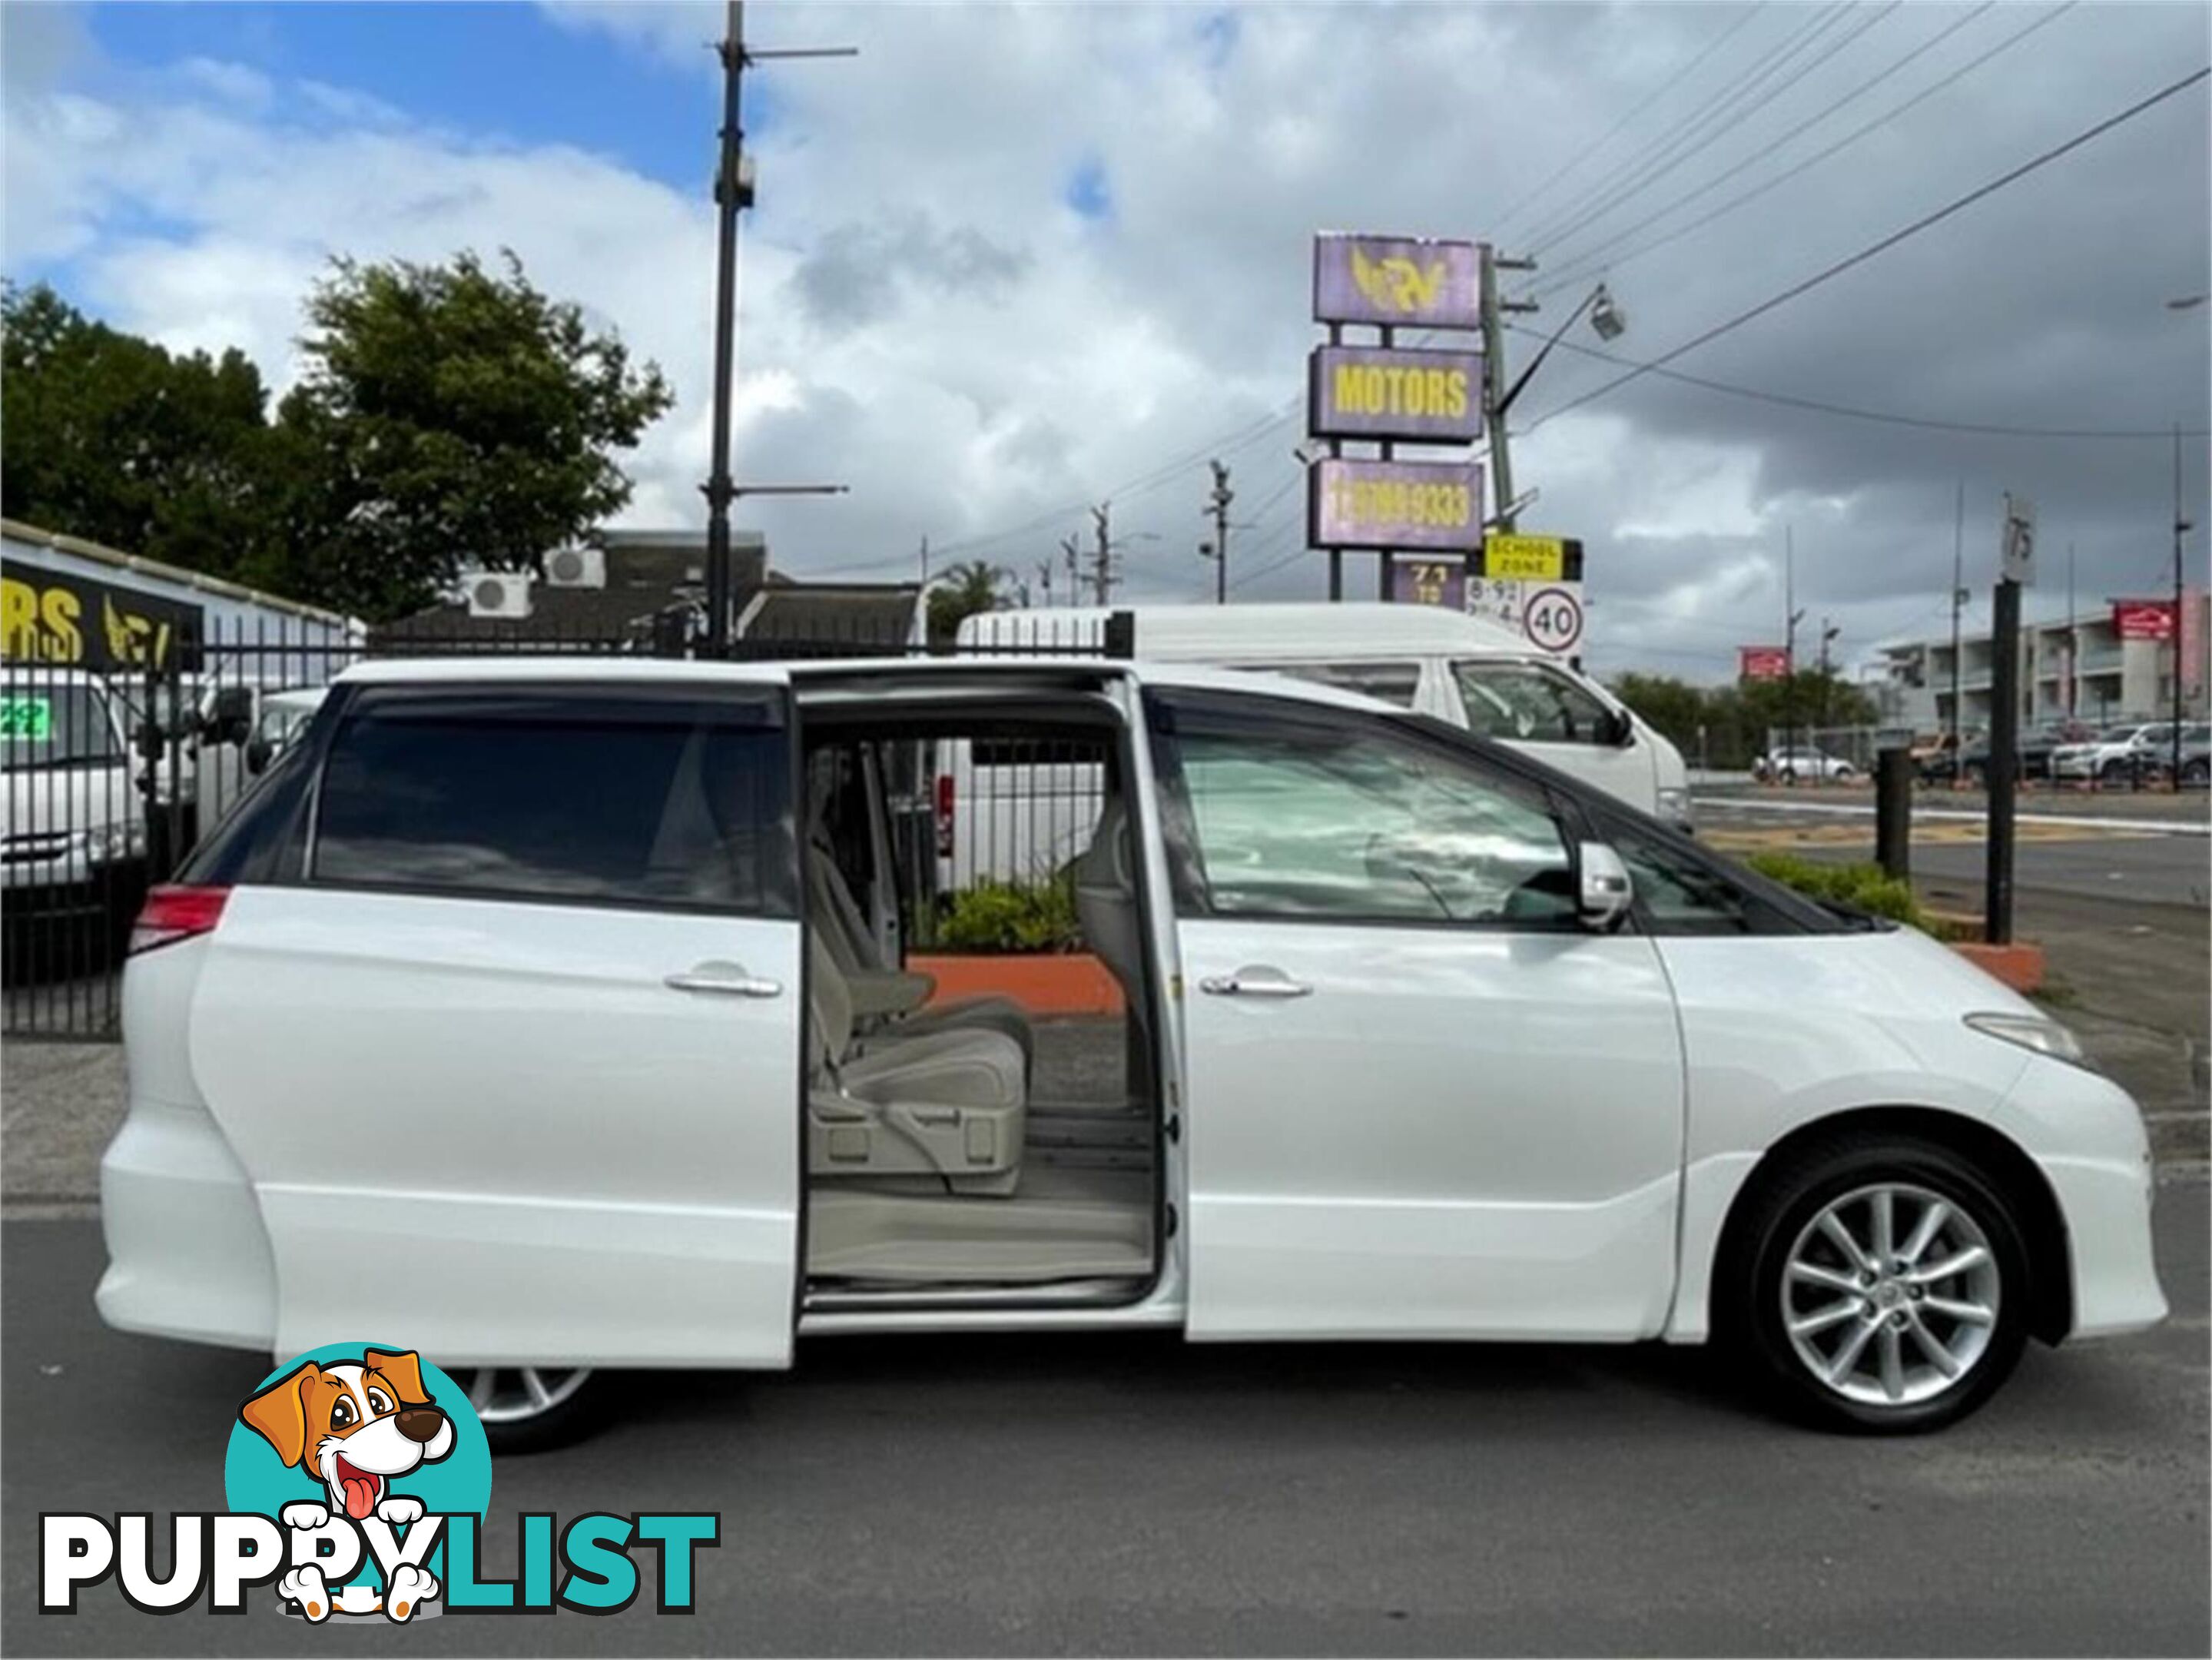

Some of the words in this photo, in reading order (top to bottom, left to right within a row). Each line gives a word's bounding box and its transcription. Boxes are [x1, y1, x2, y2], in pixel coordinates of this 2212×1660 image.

[1335, 364, 1467, 418] MOTORS
[1491, 540, 1557, 557] SCHOOL
[1501, 559, 1544, 573] ZONE
[1534, 606, 1573, 636] 40
